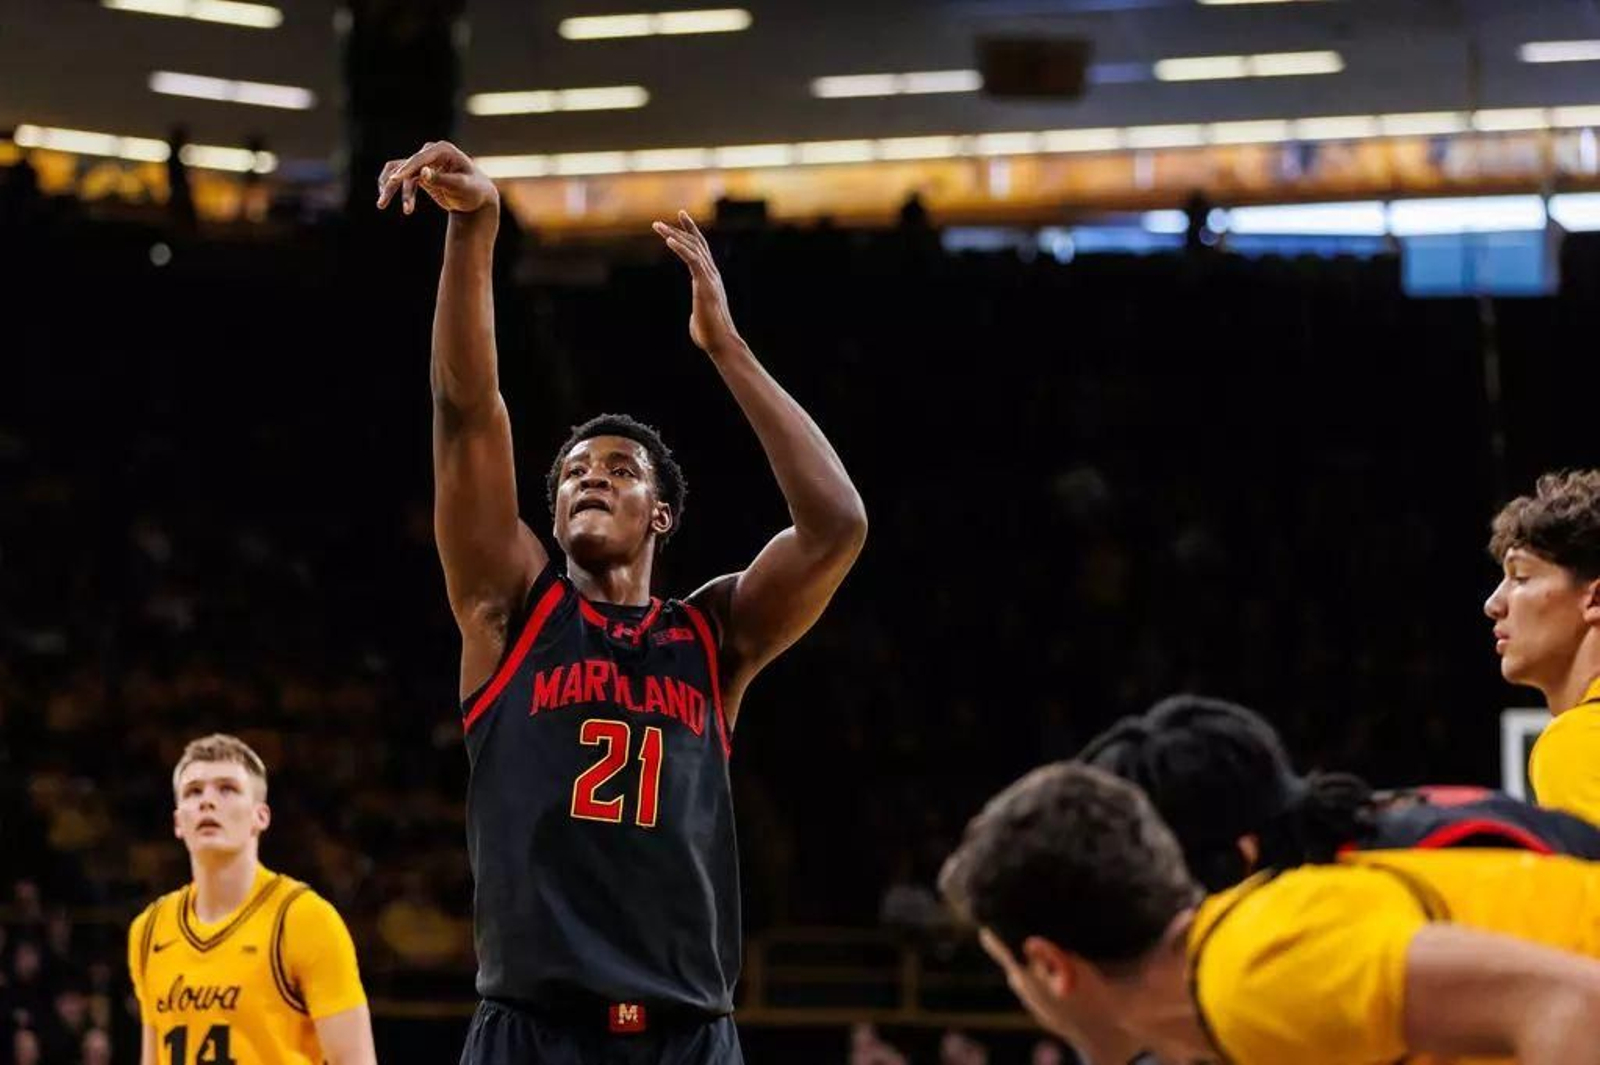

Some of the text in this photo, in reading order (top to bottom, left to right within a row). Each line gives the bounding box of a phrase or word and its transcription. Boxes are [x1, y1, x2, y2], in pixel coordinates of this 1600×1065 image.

[529, 660, 706, 736] MARYLAND
[571, 718, 663, 827] 21
[157, 975, 241, 1013] Iowa
[618, 1003, 639, 1026] M
[163, 1024, 238, 1065] 14
